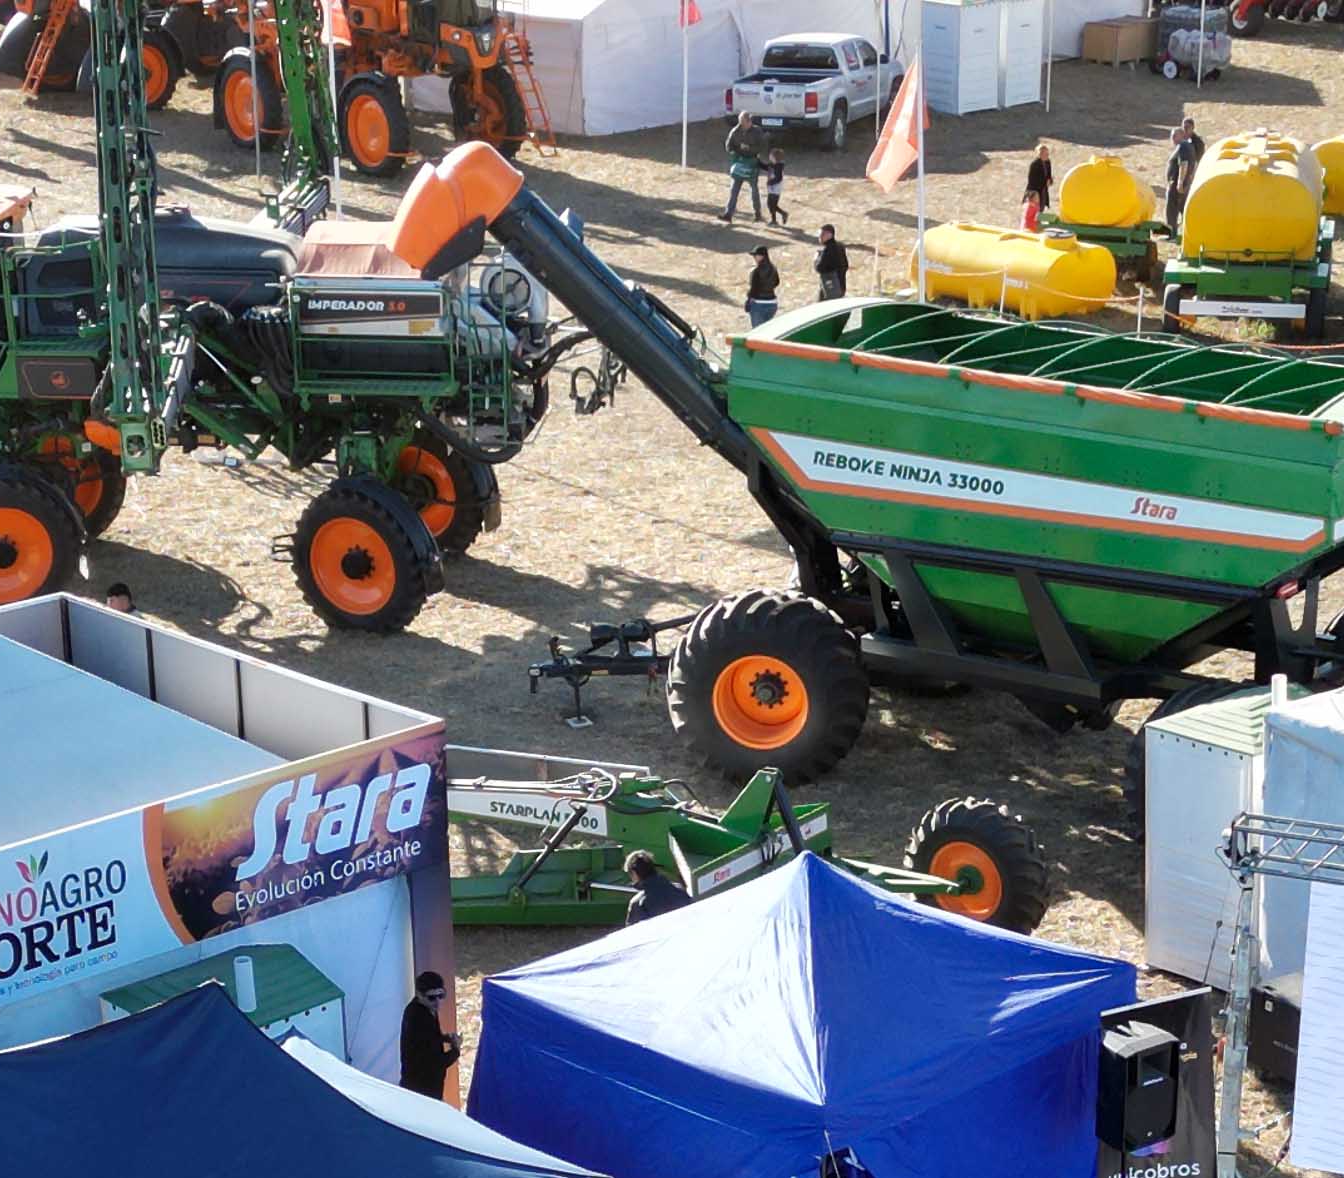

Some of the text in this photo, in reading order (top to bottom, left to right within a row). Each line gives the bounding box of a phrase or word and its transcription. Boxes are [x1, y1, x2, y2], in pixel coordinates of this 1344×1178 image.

[307, 299, 386, 312] IMPERADOR
[813, 451, 1004, 495] REBOKE NINJA 33000
[1129, 496, 1177, 521] Stara
[235, 762, 432, 881] Stara
[490, 800, 563, 822] STARPLAN
[235, 838, 422, 913] Evolución Constante
